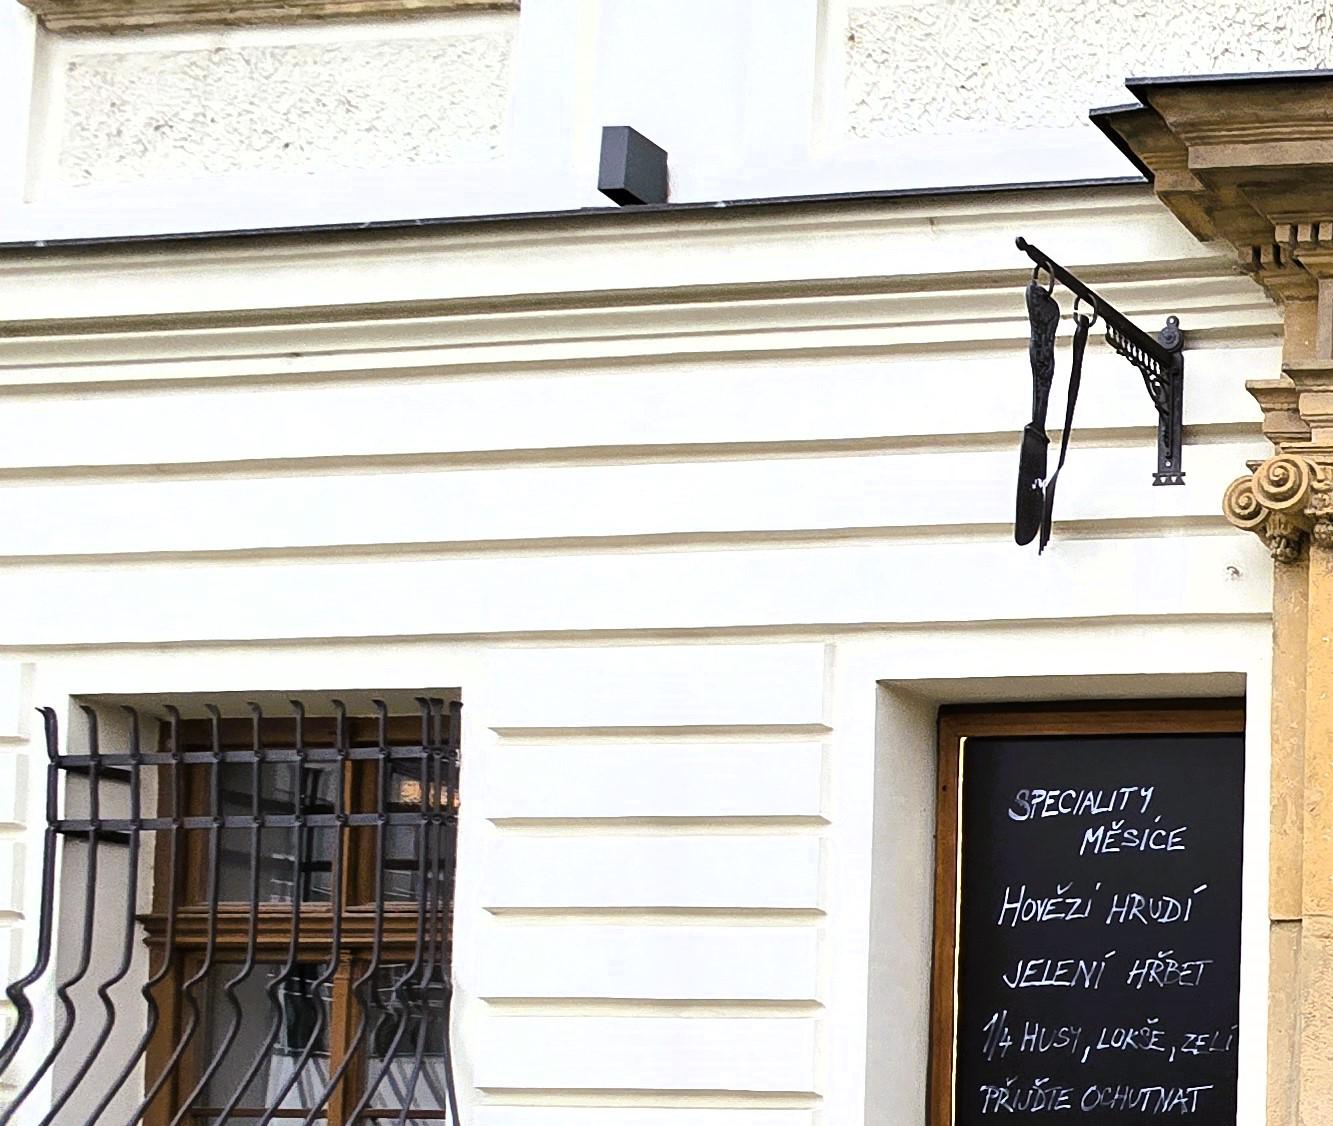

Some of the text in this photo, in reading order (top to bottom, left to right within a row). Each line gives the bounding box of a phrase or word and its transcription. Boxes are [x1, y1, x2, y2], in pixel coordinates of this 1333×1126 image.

[1008, 786, 1154, 820] SPECIALITY
[997, 882, 1208, 927] HOVĚZÍ HRUDÍ
[1003, 950, 1214, 989] JELENÍ HŘBET
[1080, 1084, 1214, 1115] OCHUTNAT
